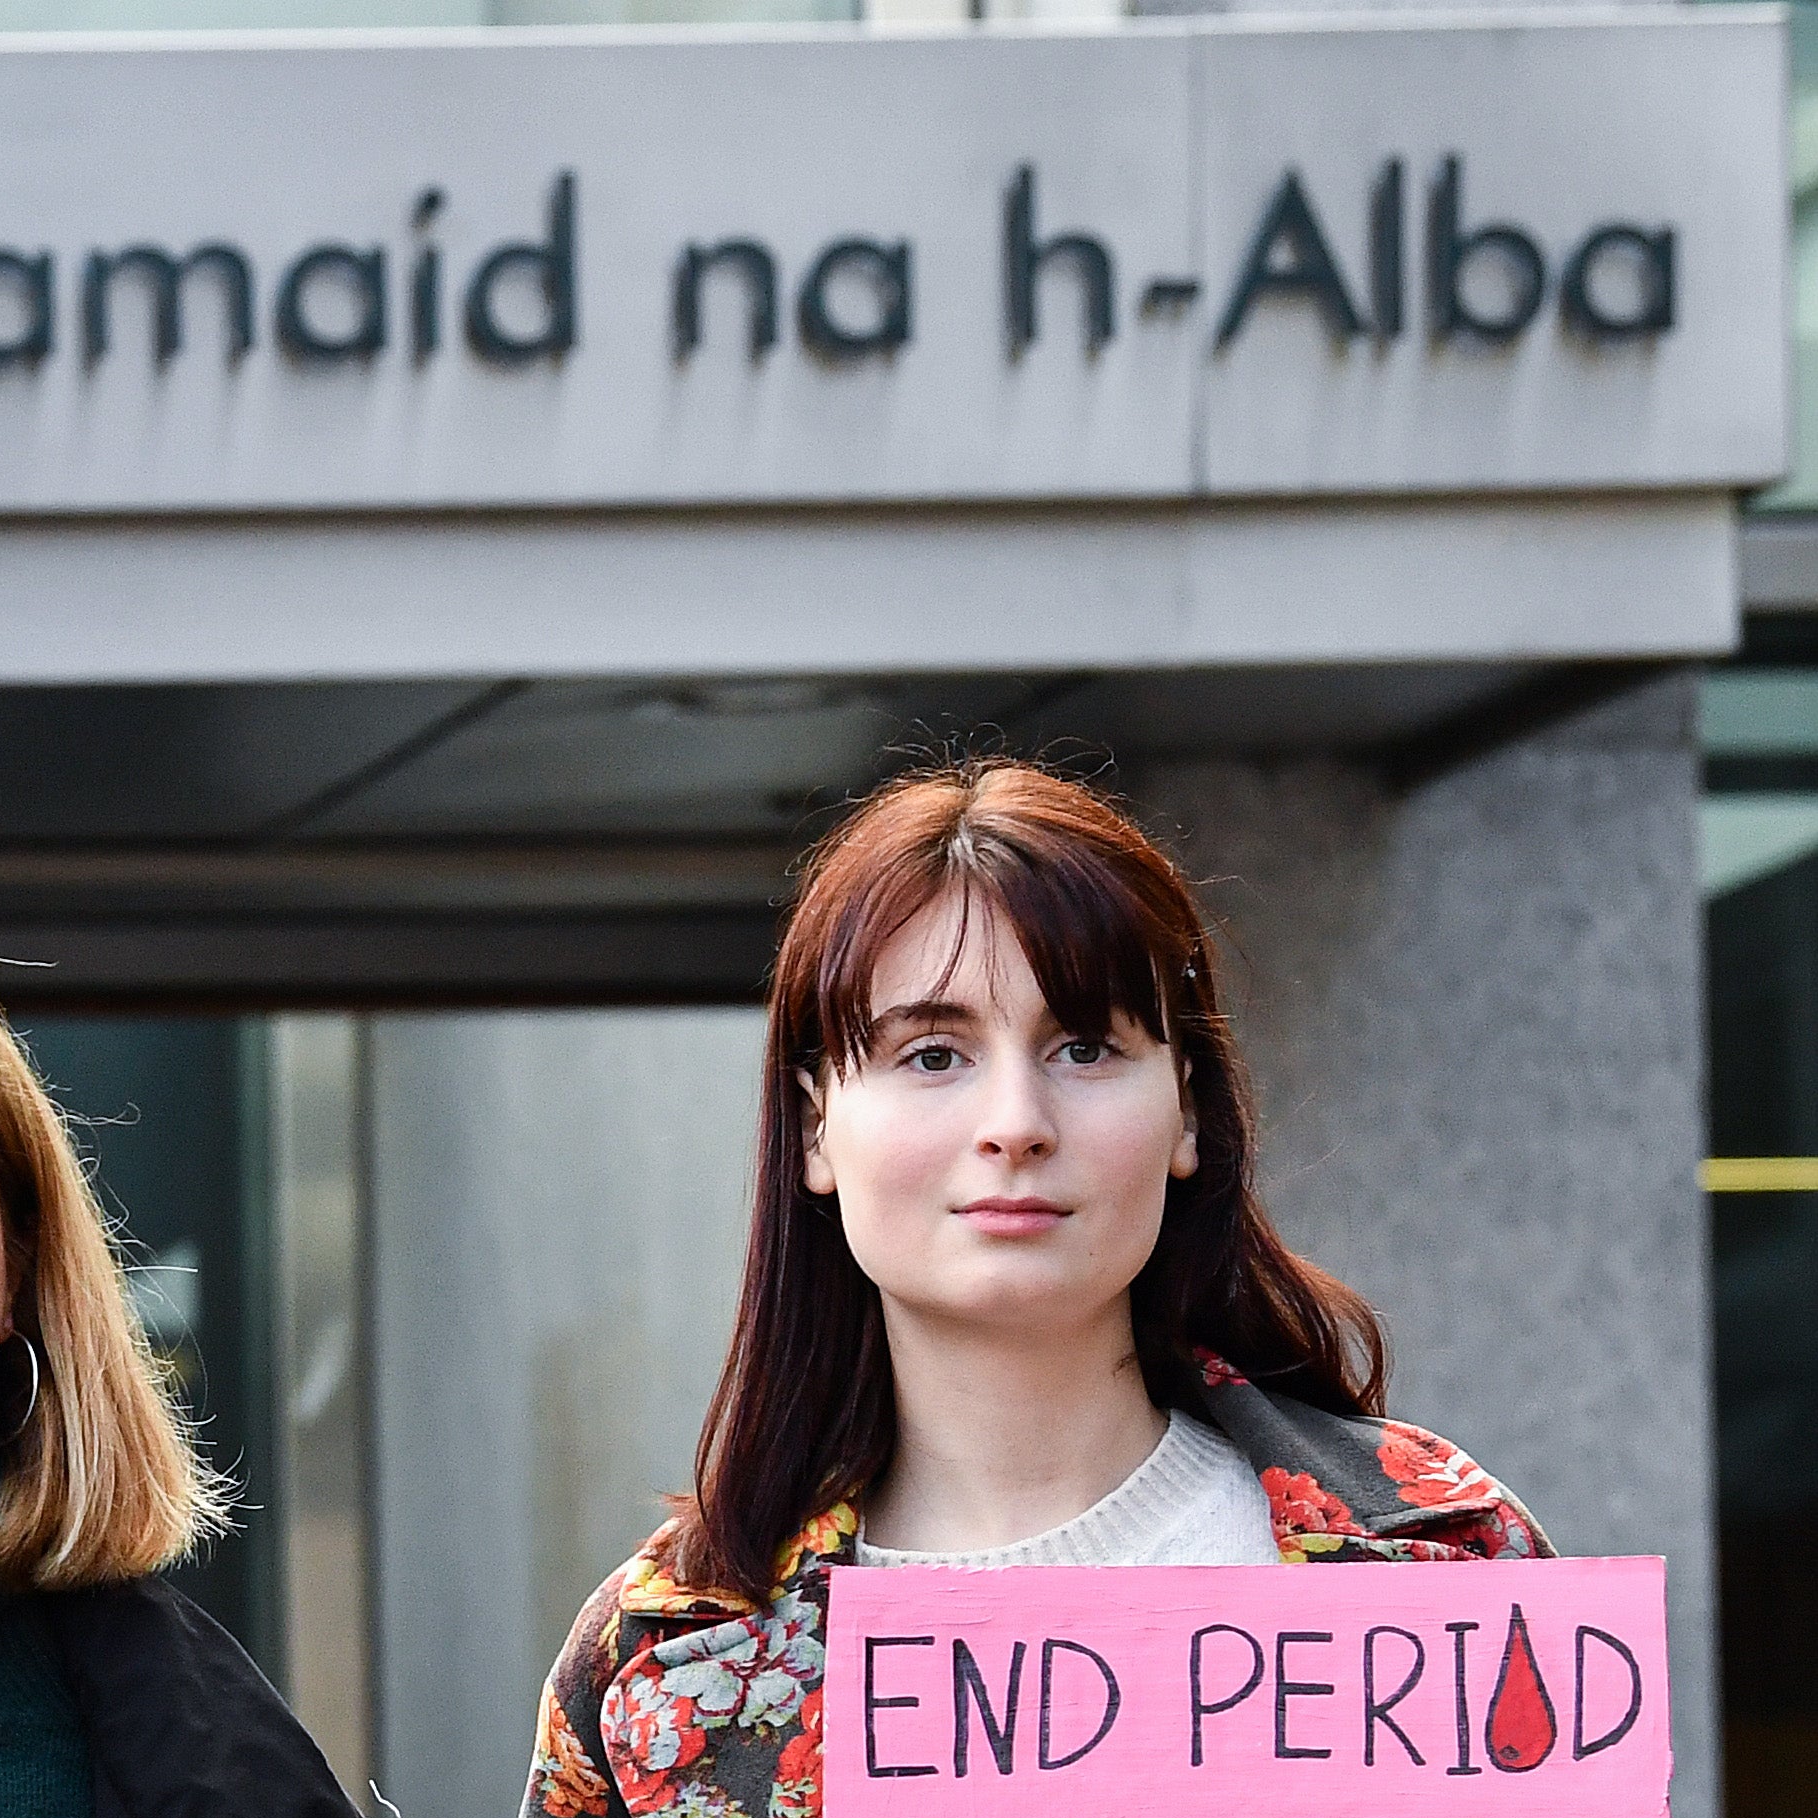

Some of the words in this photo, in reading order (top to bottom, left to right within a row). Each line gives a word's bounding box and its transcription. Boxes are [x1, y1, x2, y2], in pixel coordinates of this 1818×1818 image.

[670, 236, 914, 367] na
[1000, 153, 1678, 367] h-Alba
[864, 1635, 1122, 1778] END
